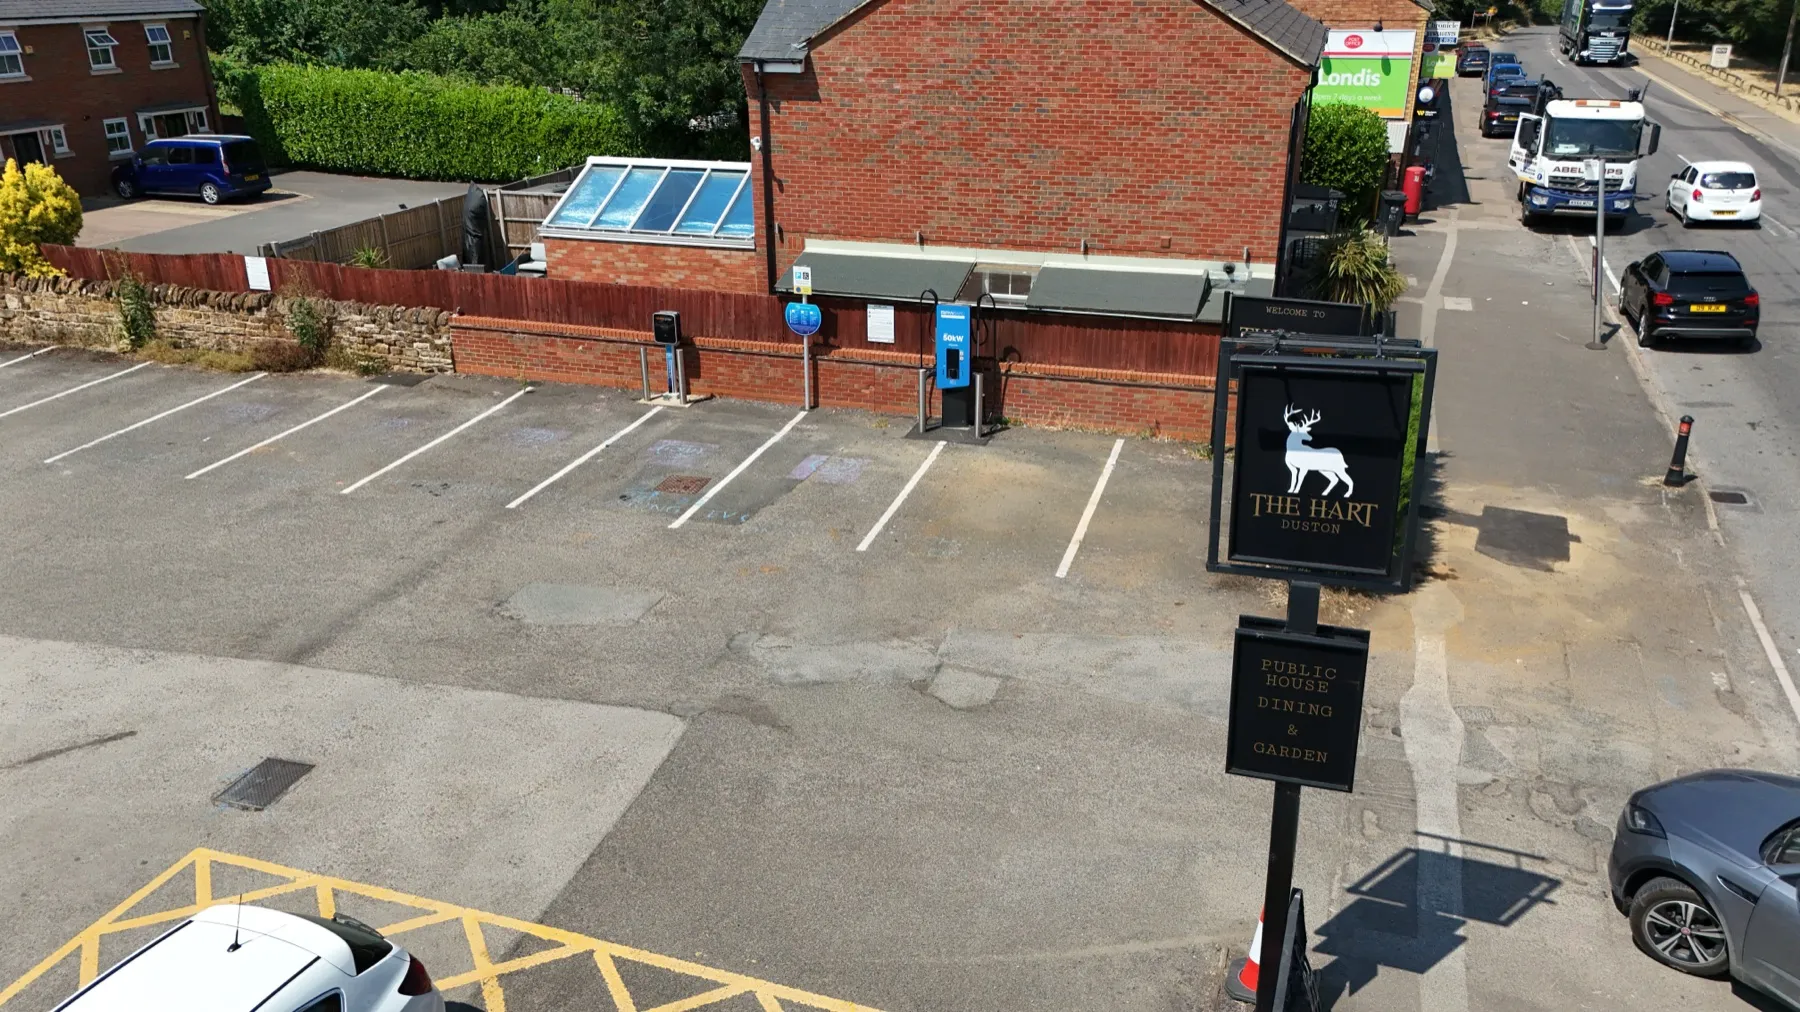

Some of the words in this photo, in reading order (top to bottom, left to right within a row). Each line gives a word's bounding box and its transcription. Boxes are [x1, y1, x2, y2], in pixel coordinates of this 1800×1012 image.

[1317, 68, 1381, 87] Londis
[1552, 166, 1585, 174] ABEL
[1265, 306, 1308, 317] WELCOME
[1313, 310, 1326, 319] TO
[943, 332, 964, 342] 50kW
[1249, 493, 1300, 517] THE
[1309, 498, 1379, 528] HART
[1281, 519, 1341, 534] DUSTON
[1261, 659, 1337, 680] PUBLIC
[1265, 674, 1329, 693] HOUSE
[1258, 696, 1333, 717] DINING
[1287, 723, 1299, 736] &
[1253, 742, 1328, 763] GARDEN
